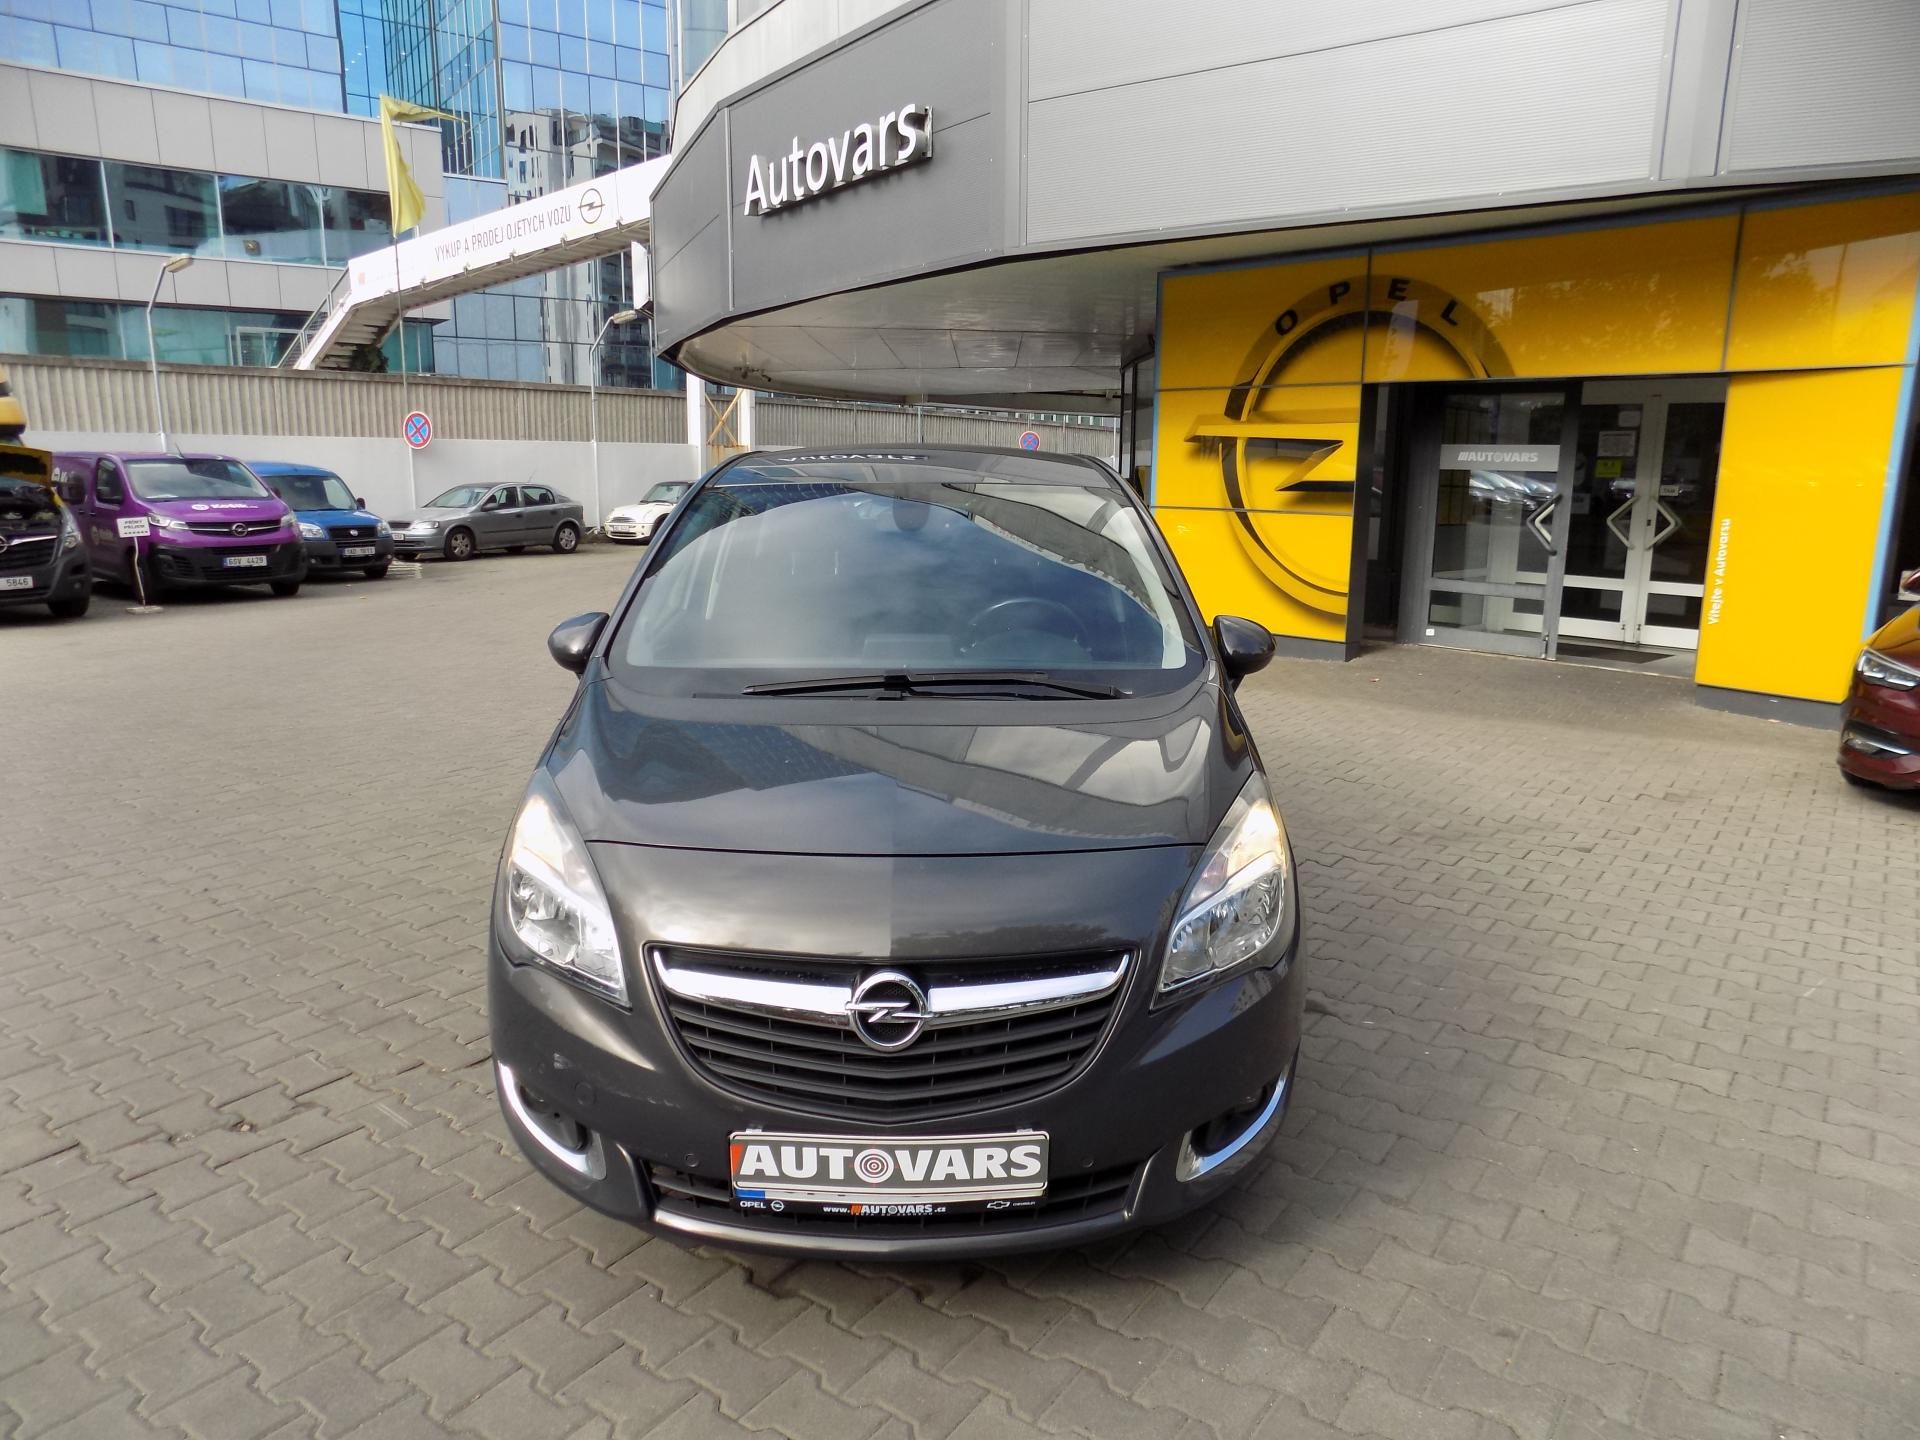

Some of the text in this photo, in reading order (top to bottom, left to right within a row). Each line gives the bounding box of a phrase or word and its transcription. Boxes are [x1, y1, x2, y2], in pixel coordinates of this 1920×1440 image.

[744, 103, 926, 216] Autovars
[464, 236, 470, 253] A
[471, 226, 504, 249] PRODEJ
[1275, 278, 1458, 336] OPEL
[1467, 451, 1538, 463] AUTOVARS
[1713, 517, 1732, 577] Autovarsu
[739, 1145, 1041, 1184] AUTOVARS
[740, 1201, 766, 1209] OPEL
